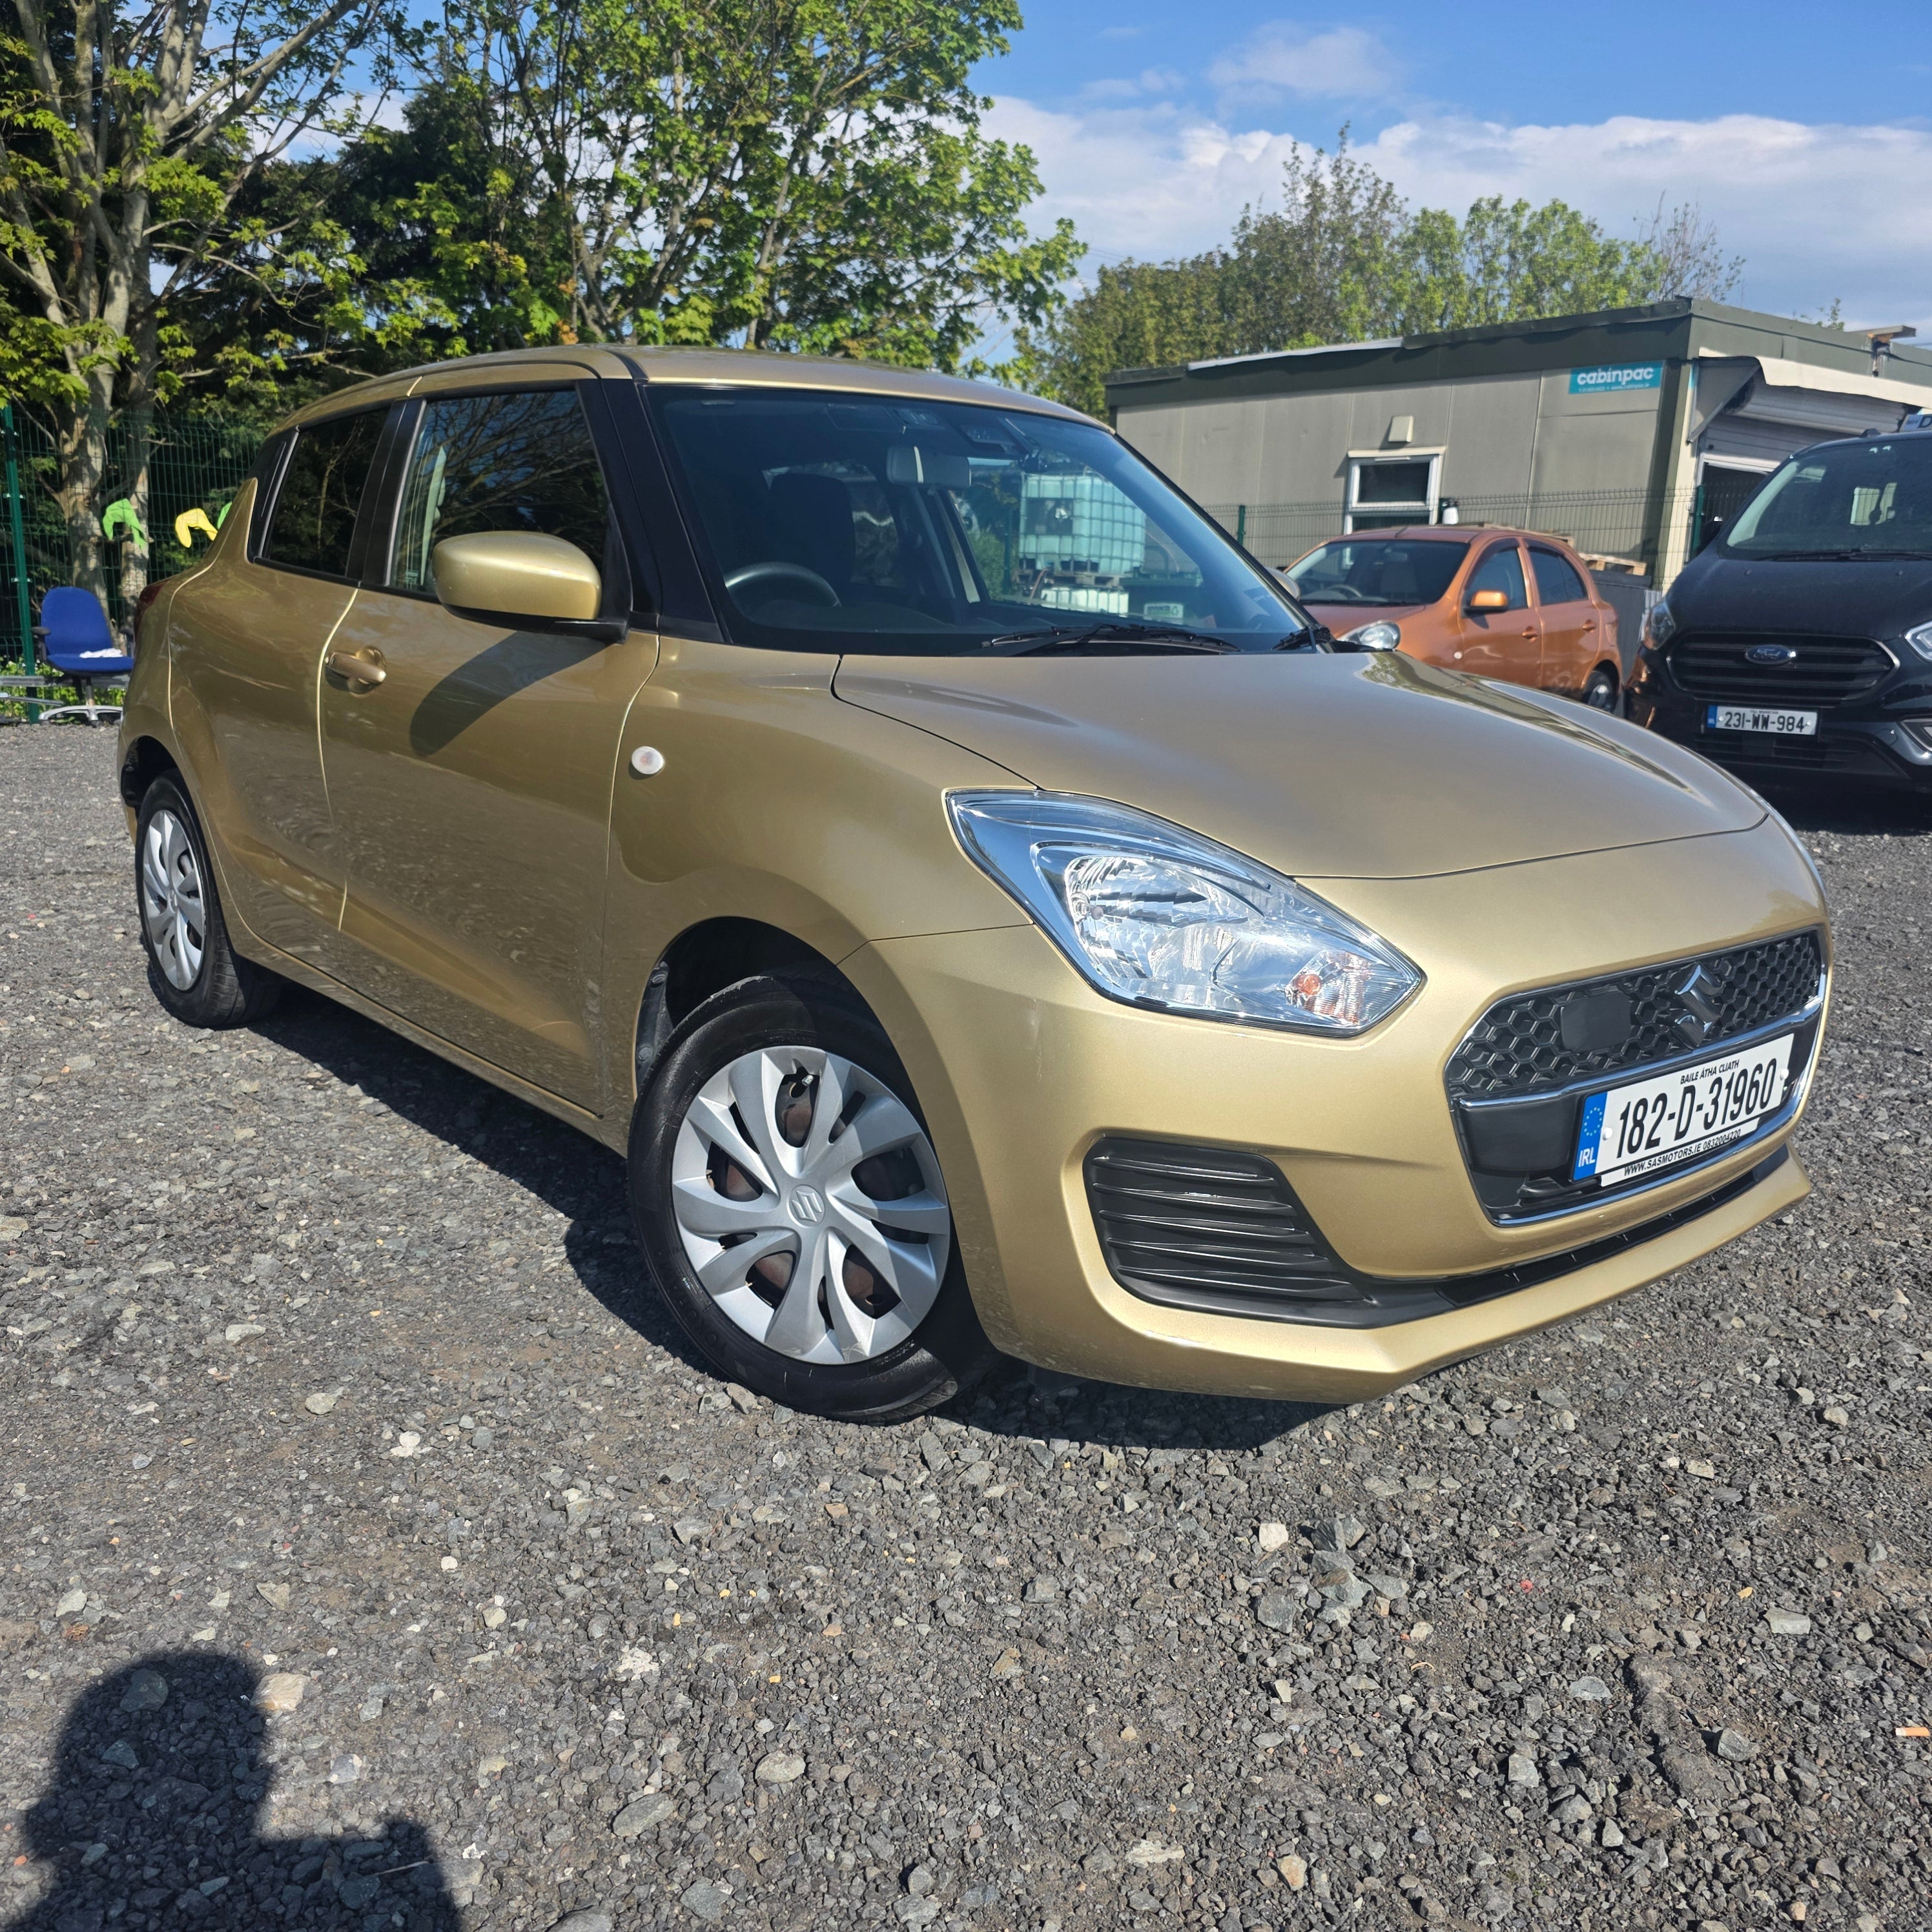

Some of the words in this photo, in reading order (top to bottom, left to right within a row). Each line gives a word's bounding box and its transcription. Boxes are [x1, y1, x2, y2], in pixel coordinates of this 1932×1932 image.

[1577, 367, 1654, 385] cabinpac
[1724, 712, 1805, 733] 231-WW-984
[1680, 1073, 1699, 1085] BAILE
[1700, 1065, 1717, 1080] ÁTHA
[1718, 1059, 1740, 1074] CLIATH
[1616, 1058, 1777, 1159] 182-D-31960
[1577, 1147, 1596, 1167] IRL
[1623, 1143, 1701, 1177] WWW.SASMOTORS.IE
[1702, 1128, 1742, 1151] 0832004220
